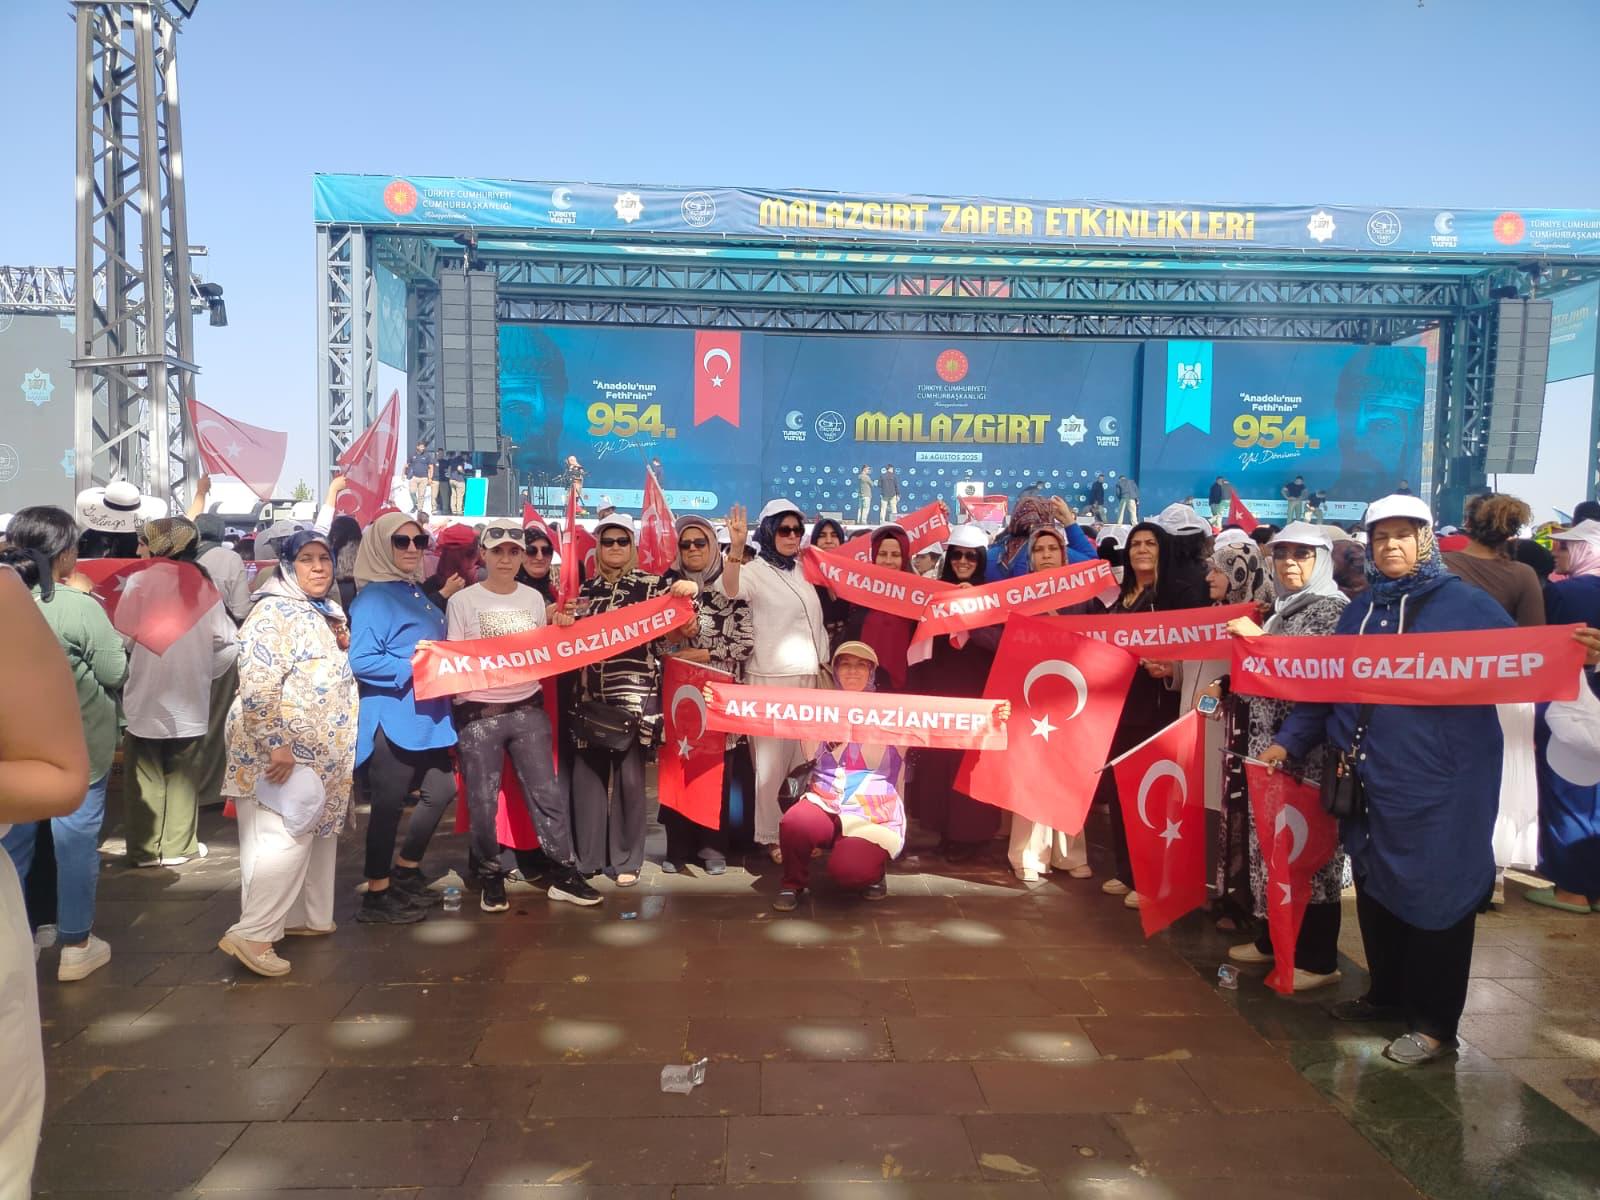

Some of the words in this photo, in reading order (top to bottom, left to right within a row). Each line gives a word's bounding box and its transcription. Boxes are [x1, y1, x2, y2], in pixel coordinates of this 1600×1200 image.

[759, 198, 928, 232] MALAZGİRT
[940, 204, 1033, 235] ZAFER
[1045, 206, 1256, 241] ETKİNLİKLERİ
[587, 401, 676, 438] 954.
[855, 411, 1051, 443] MALAZGİRT
[1232, 414, 1320, 449] 954.
[846, 571, 906, 601] KADIN
[932, 592, 1001, 619] KADIN
[1006, 563, 1112, 605] GAZİANTE
[438, 655, 473, 676] AK
[478, 645, 552, 671] KADIN
[557, 607, 677, 658] GAZİANTEP
[1113, 622, 1233, 647] GAZİANTE
[1241, 655, 1272, 676] AK
[1273, 656, 1345, 680] KADIN
[1352, 651, 1544, 680] GAZİANTEP
[725, 699, 757, 719] AK
[765, 702, 840, 724] KADIN
[847, 706, 986, 731] GAZİANTEP
